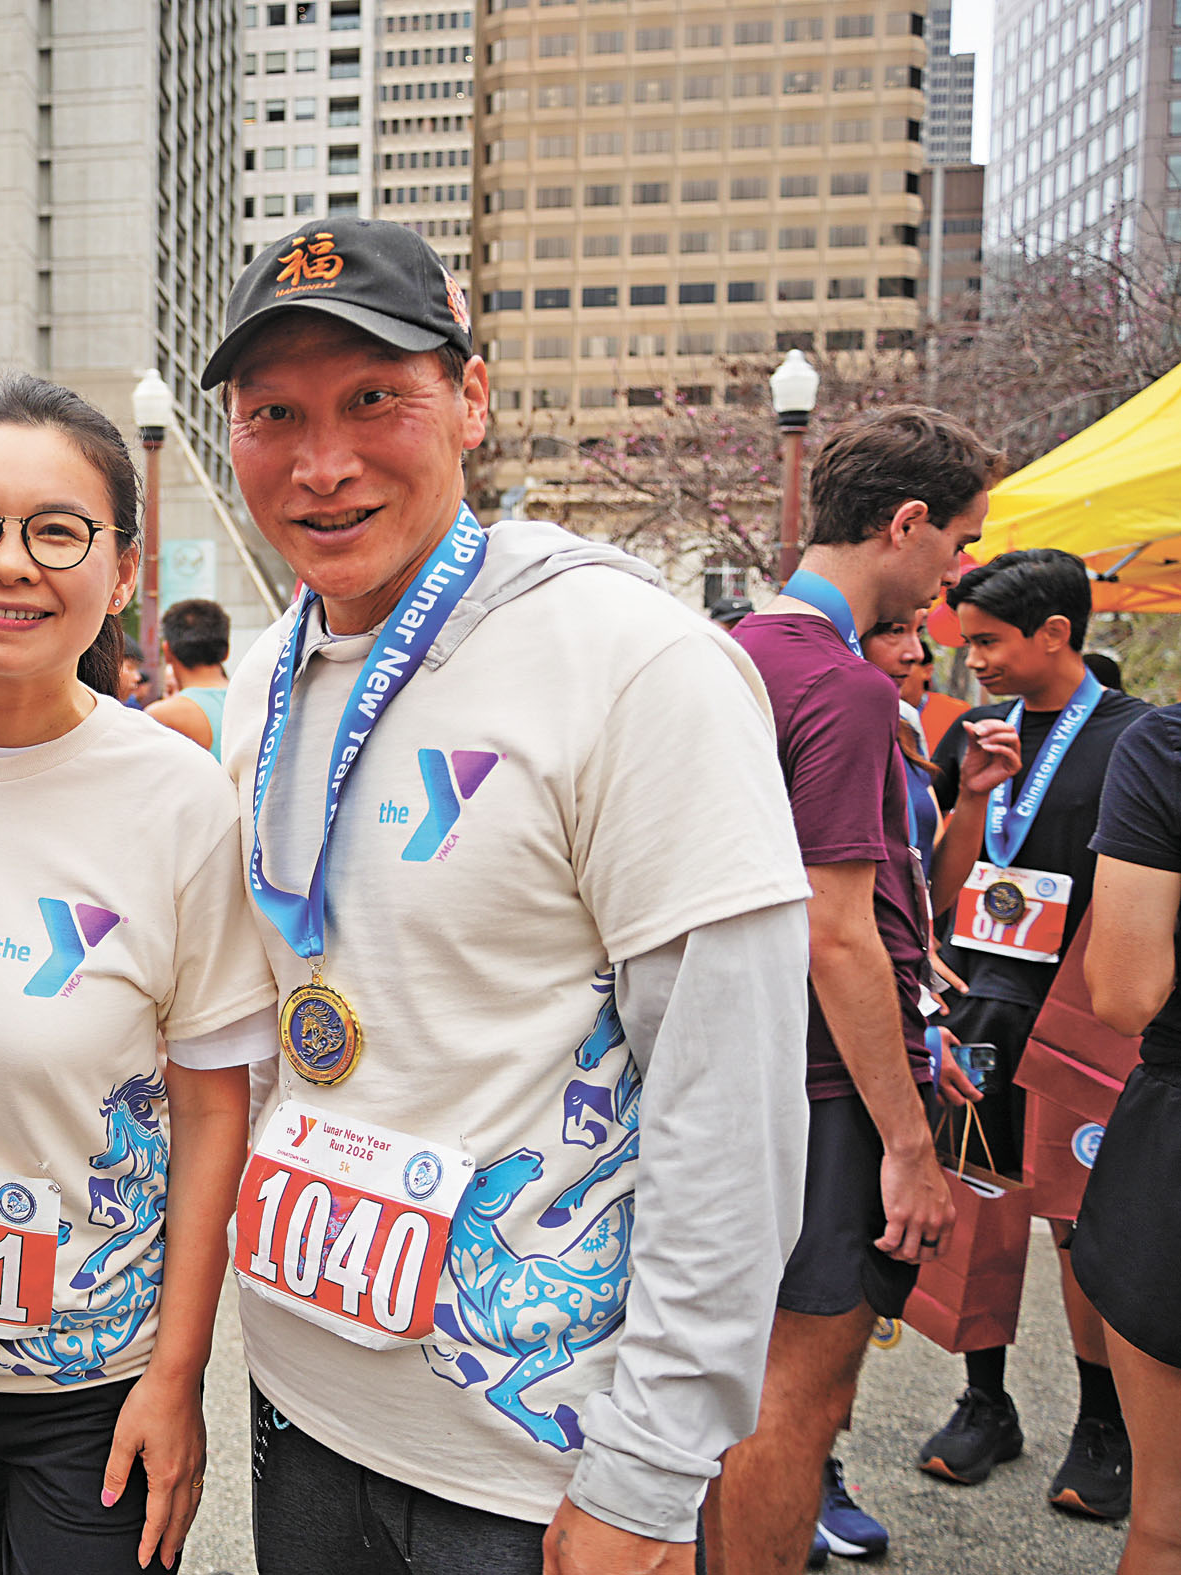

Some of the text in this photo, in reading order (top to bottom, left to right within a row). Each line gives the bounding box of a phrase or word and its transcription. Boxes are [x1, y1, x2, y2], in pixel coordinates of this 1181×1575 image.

[276, 232, 345, 286] 福
[395, 561, 466, 644] Lunar
[357, 646, 411, 720] New
[332, 727, 372, 795] Year
[1016, 703, 1088, 818] Chinatown YMCA
[379, 800, 409, 824] the
[991, 806, 1008, 834] Run
[436, 834, 460, 862] YMCA
[971, 893, 1043, 947] 87
[60, 973, 84, 999] YMCA
[286, 1127, 296, 1136] the
[323, 1122, 391, 1152] Lunar New Year
[329, 1138, 374, 1162] Run 2026
[339, 1161, 351, 1173] 5k
[249, 1169, 430, 1333] 1040
